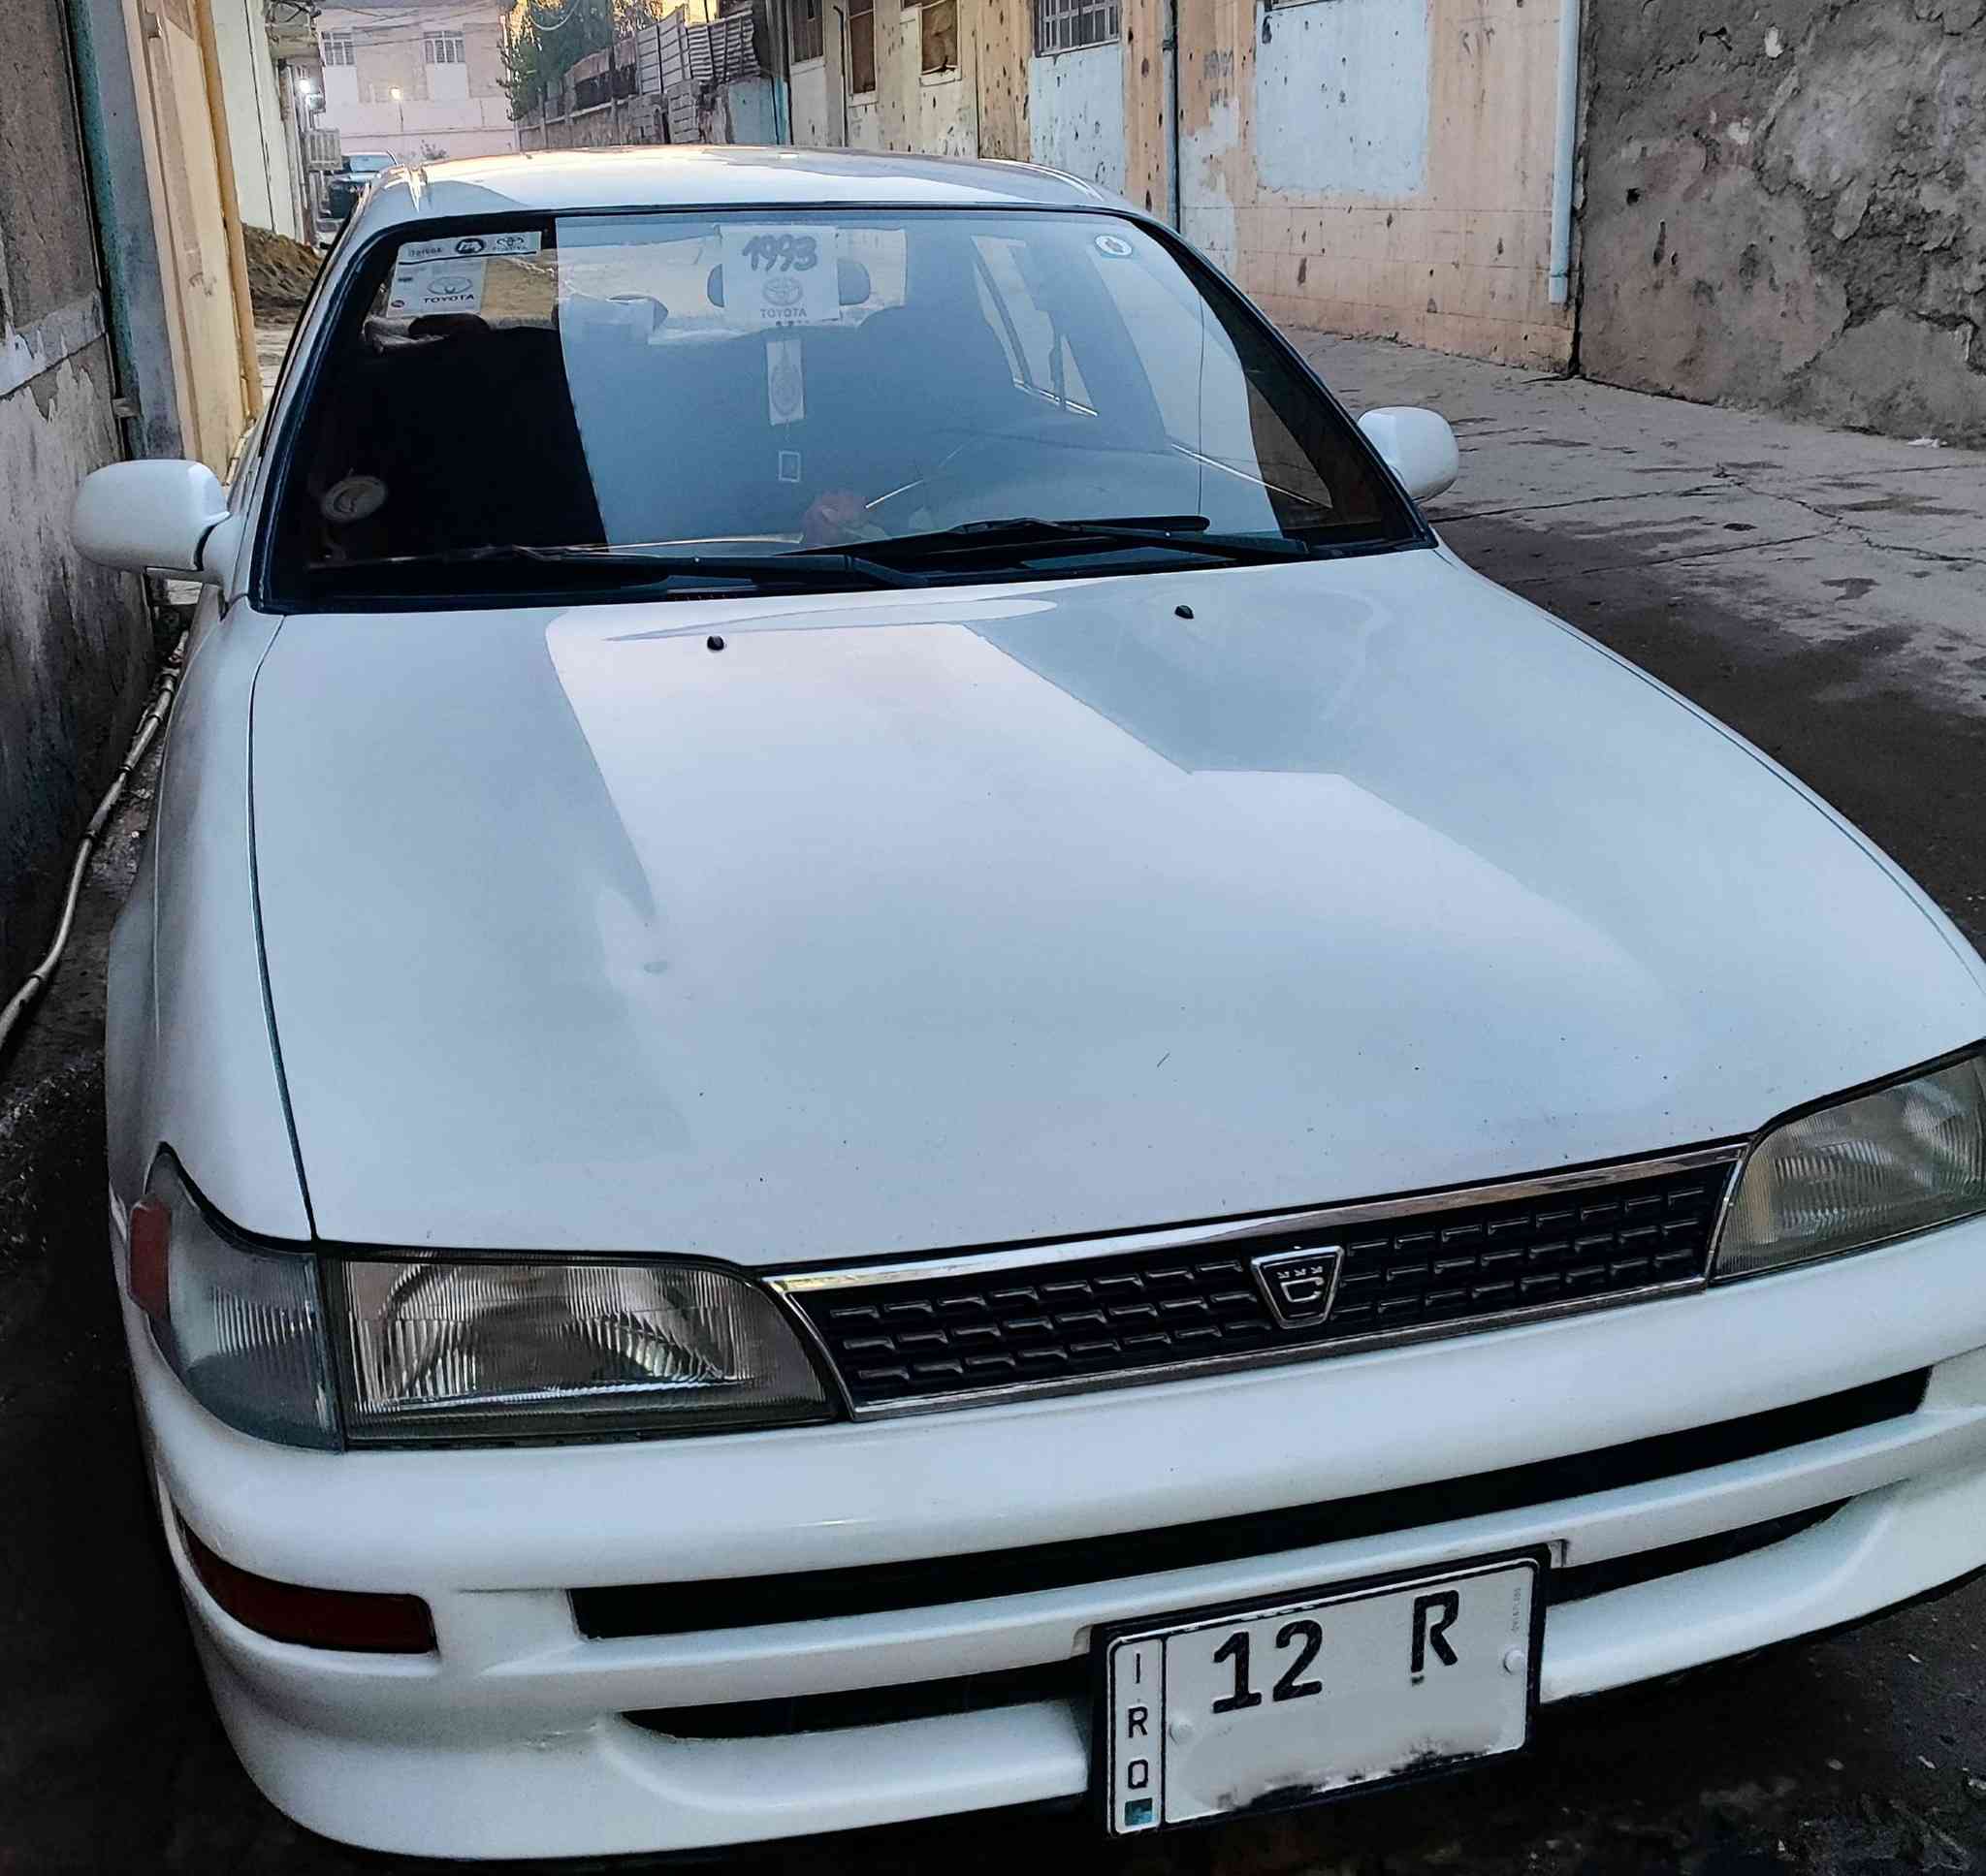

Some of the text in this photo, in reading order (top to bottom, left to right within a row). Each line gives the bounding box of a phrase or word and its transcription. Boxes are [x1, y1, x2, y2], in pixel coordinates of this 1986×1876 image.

[742, 234, 818, 271] 1993
[424, 294, 474, 303] TOYOTA
[760, 307, 807, 319] TOYOTA
[1213, 1619, 1323, 1714] 12
[1412, 1590, 1459, 1686] R
